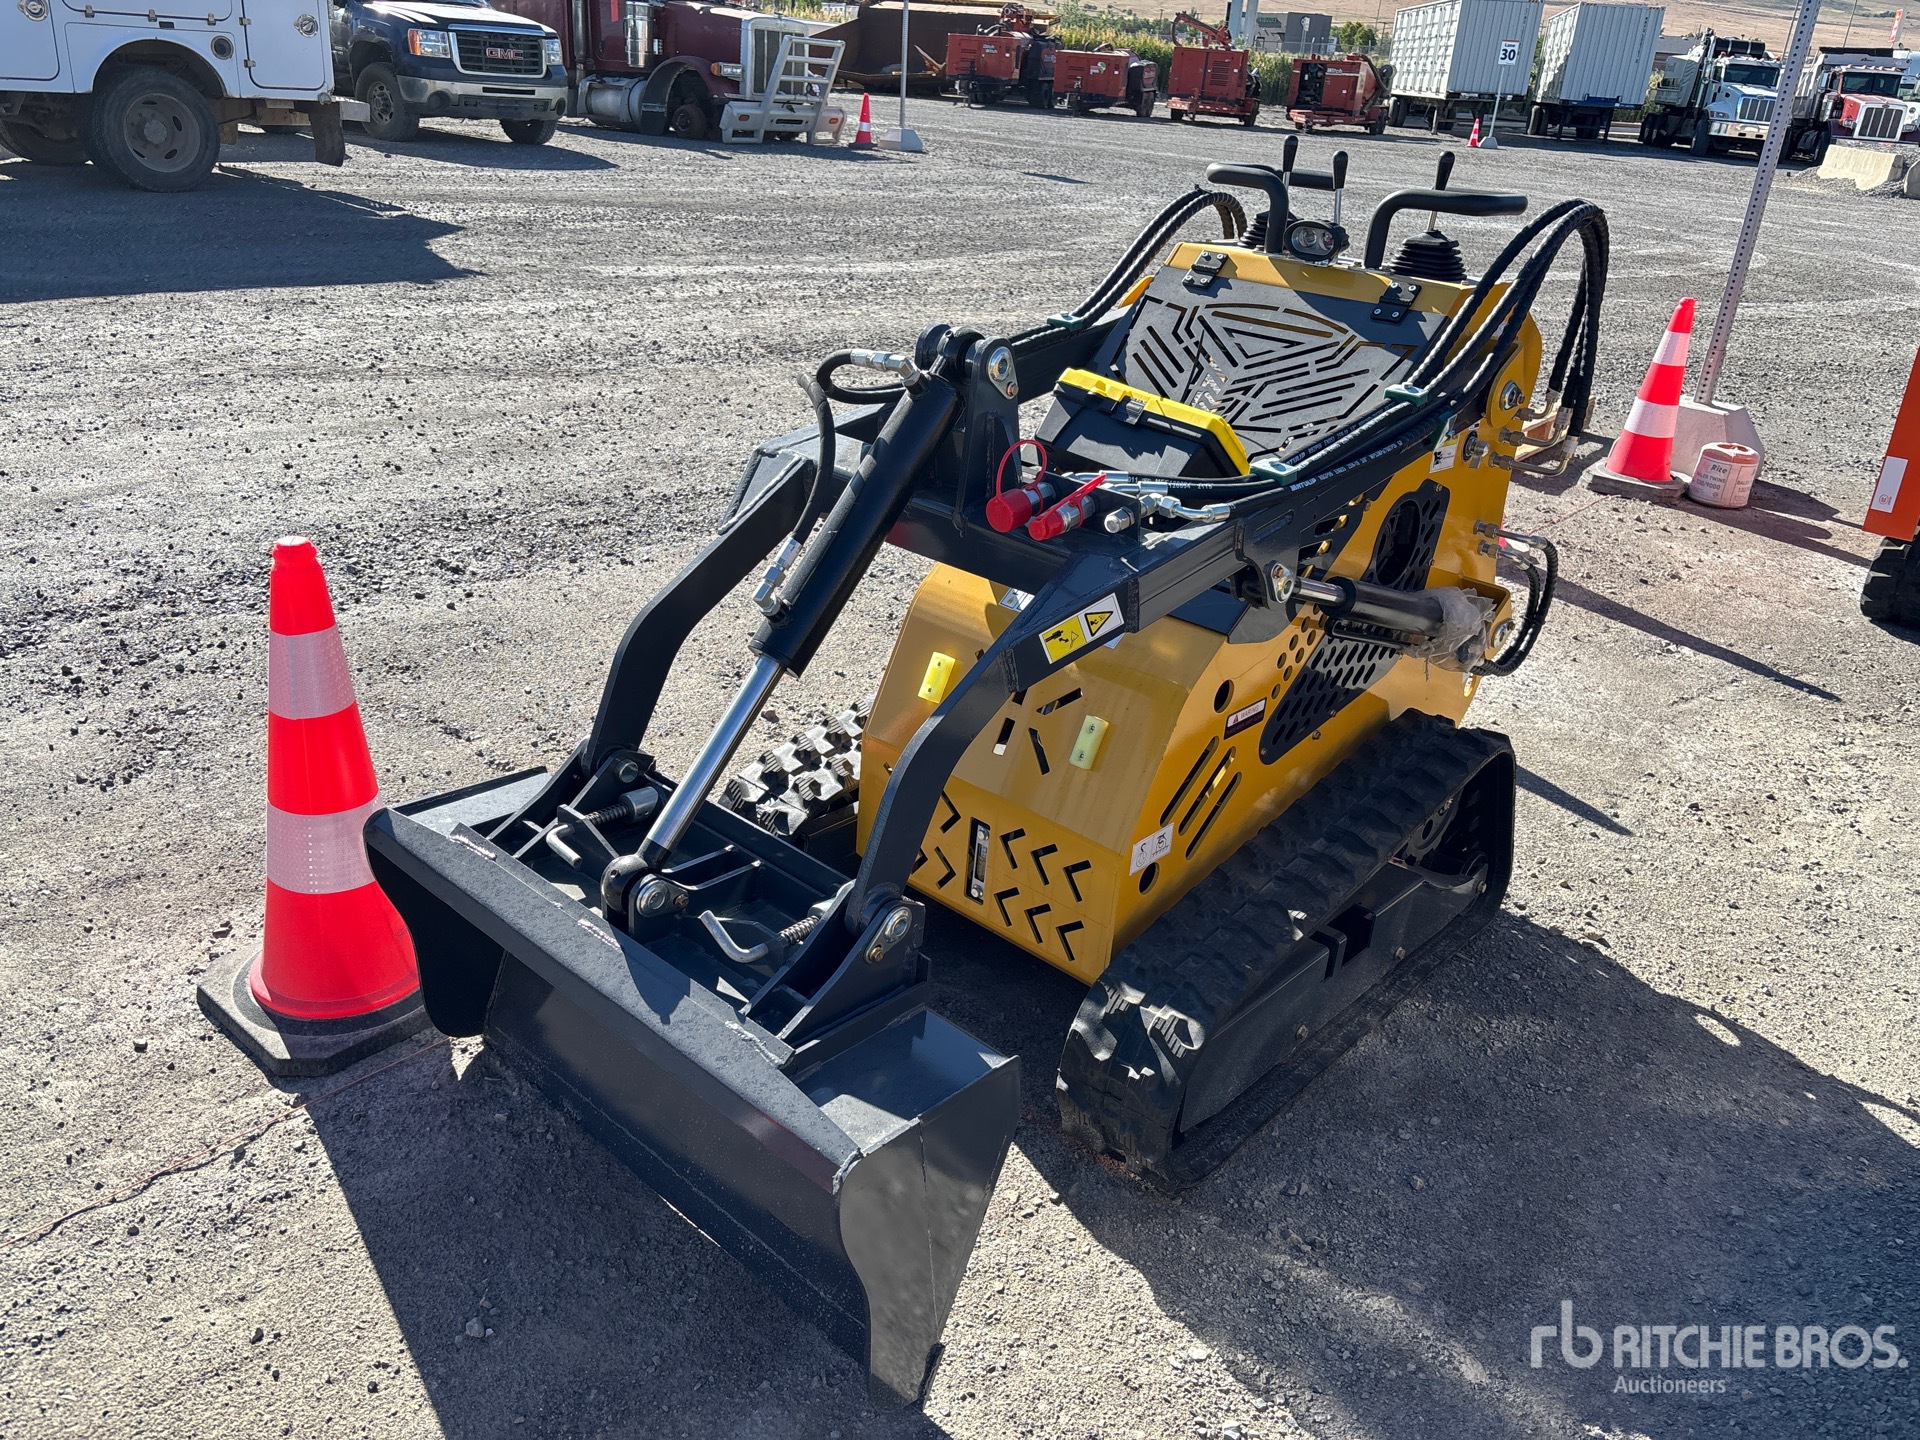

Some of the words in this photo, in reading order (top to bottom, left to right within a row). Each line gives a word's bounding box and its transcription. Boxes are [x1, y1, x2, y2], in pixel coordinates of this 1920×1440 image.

[486, 47, 523, 60] GMC
[1500, 48, 1517, 61] 30
[1710, 464, 1728, 474] Rite
